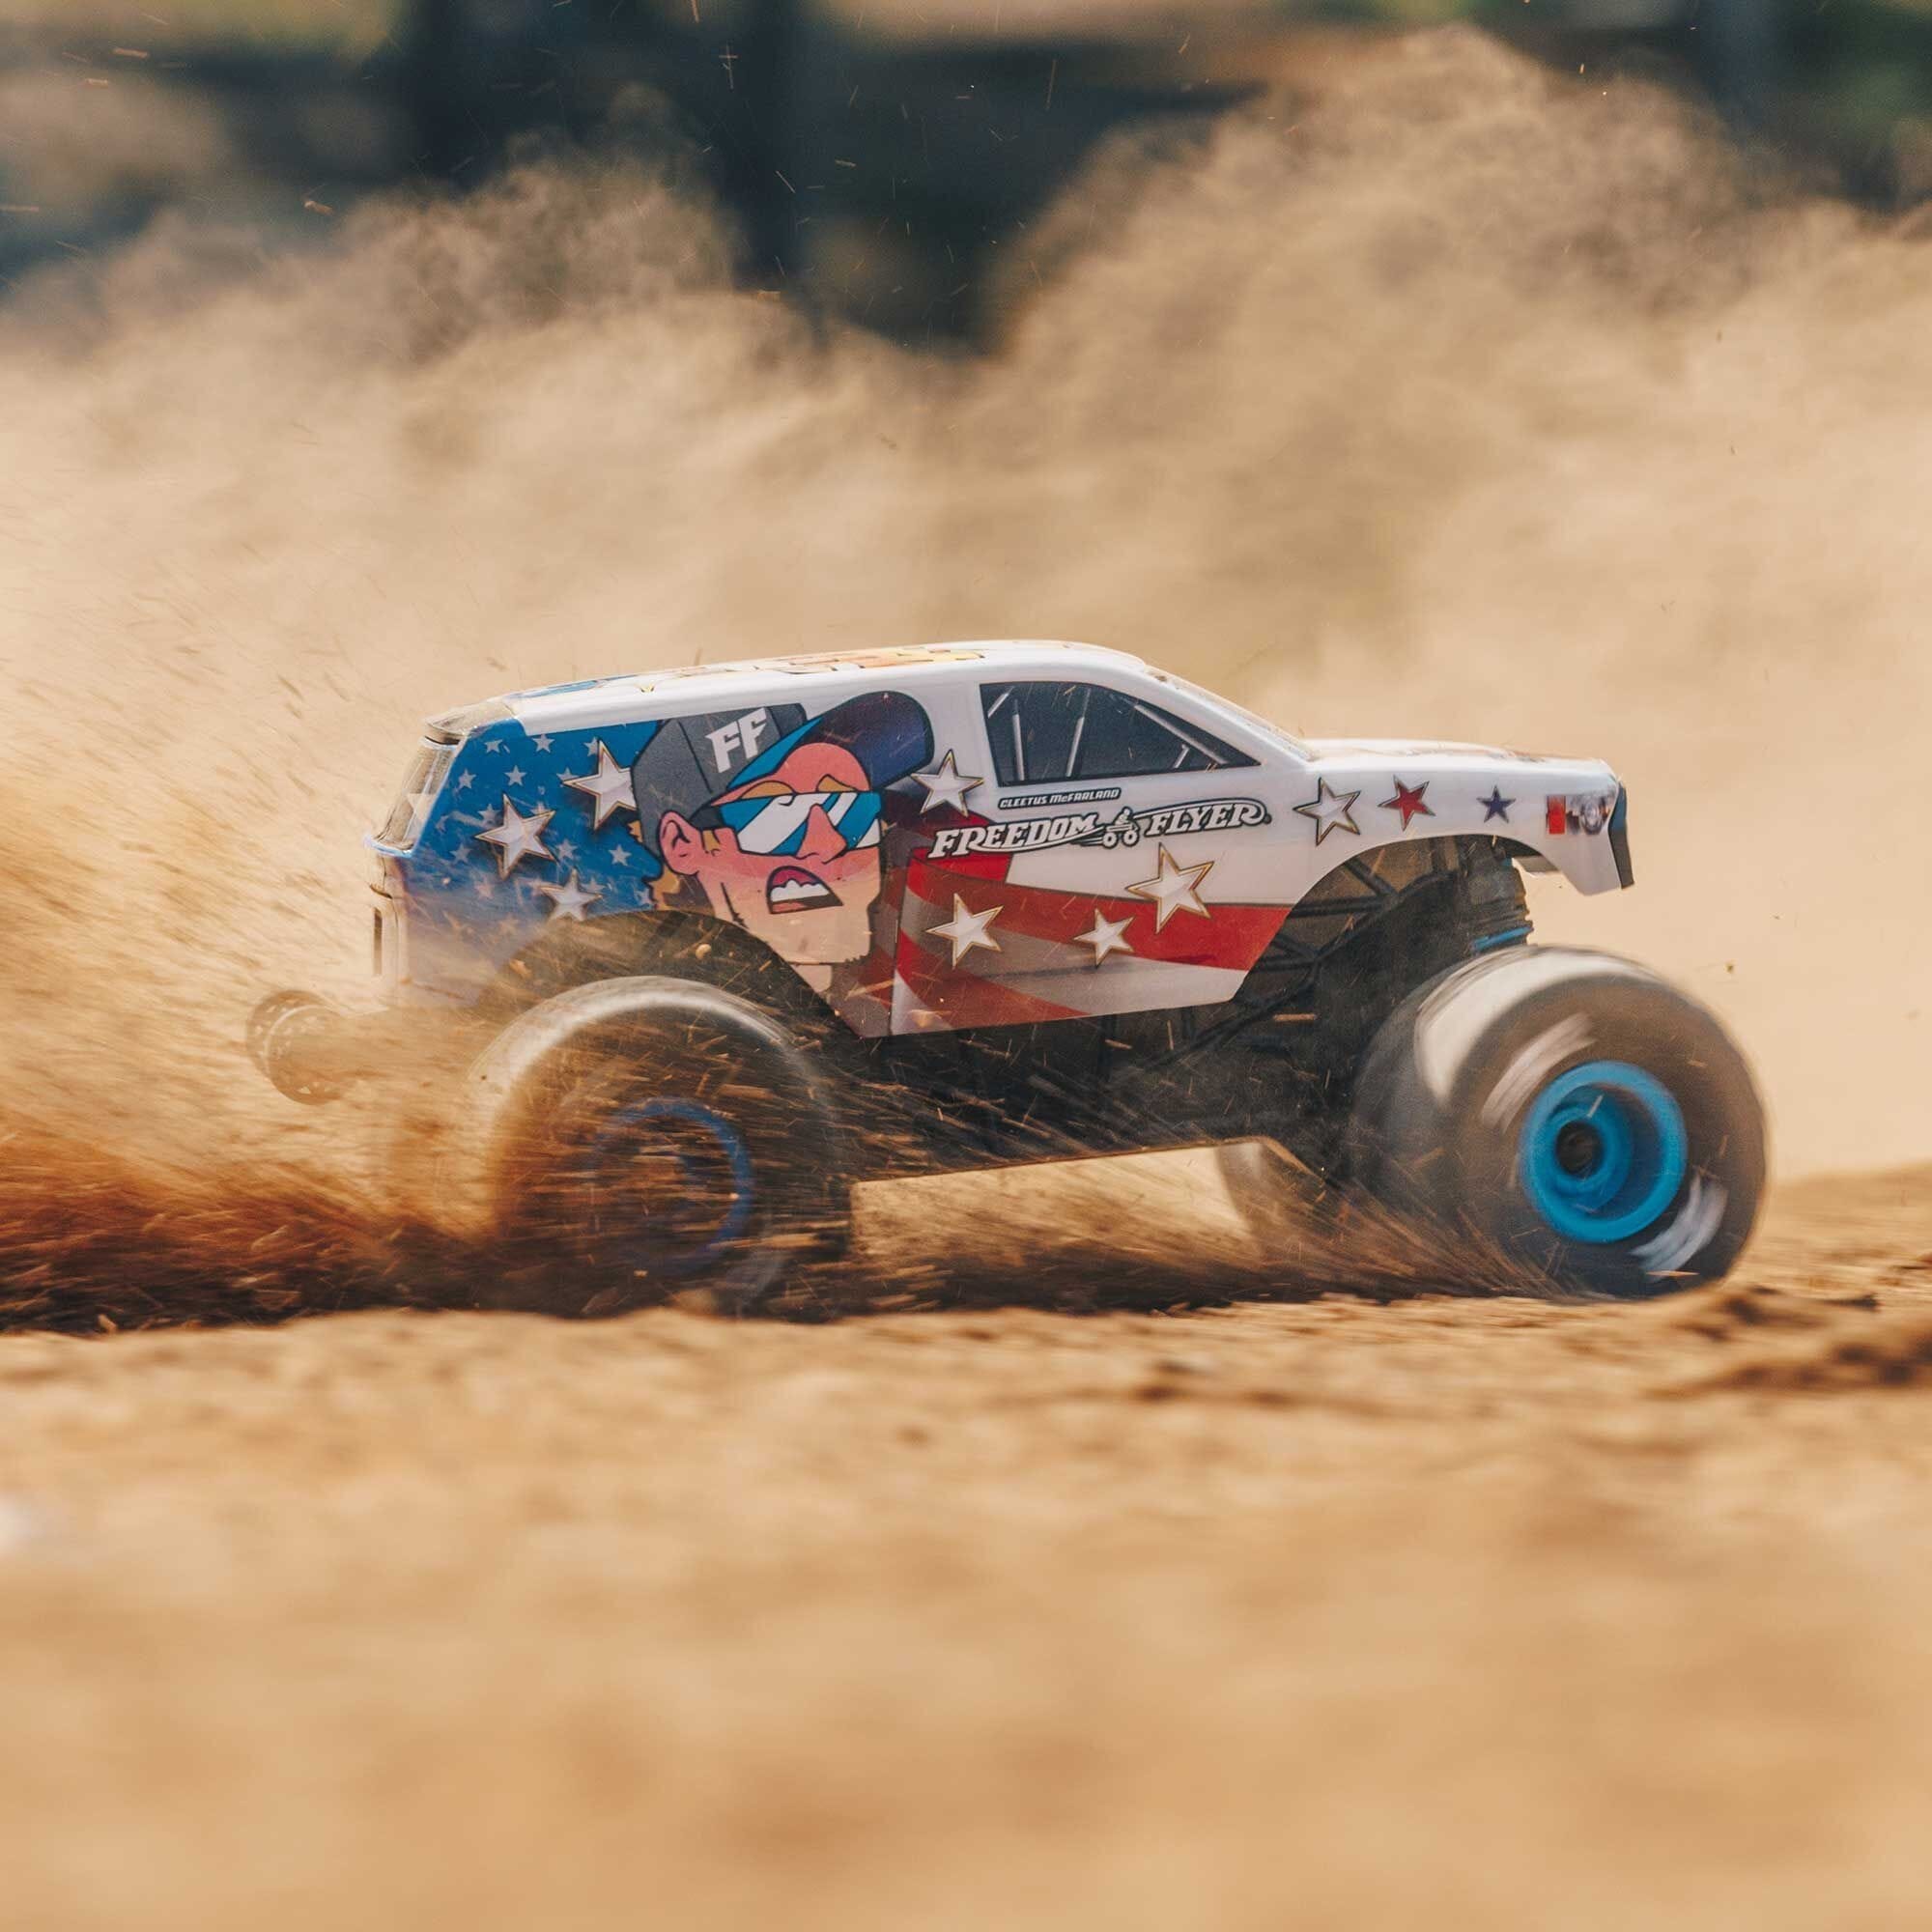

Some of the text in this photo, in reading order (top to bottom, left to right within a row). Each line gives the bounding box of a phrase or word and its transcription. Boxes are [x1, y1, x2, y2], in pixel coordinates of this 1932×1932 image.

[704, 707, 767, 774] FF
[926, 800, 1270, 859] FREEDOM FLYER
[999, 795, 1047, 809] CLEETUS
